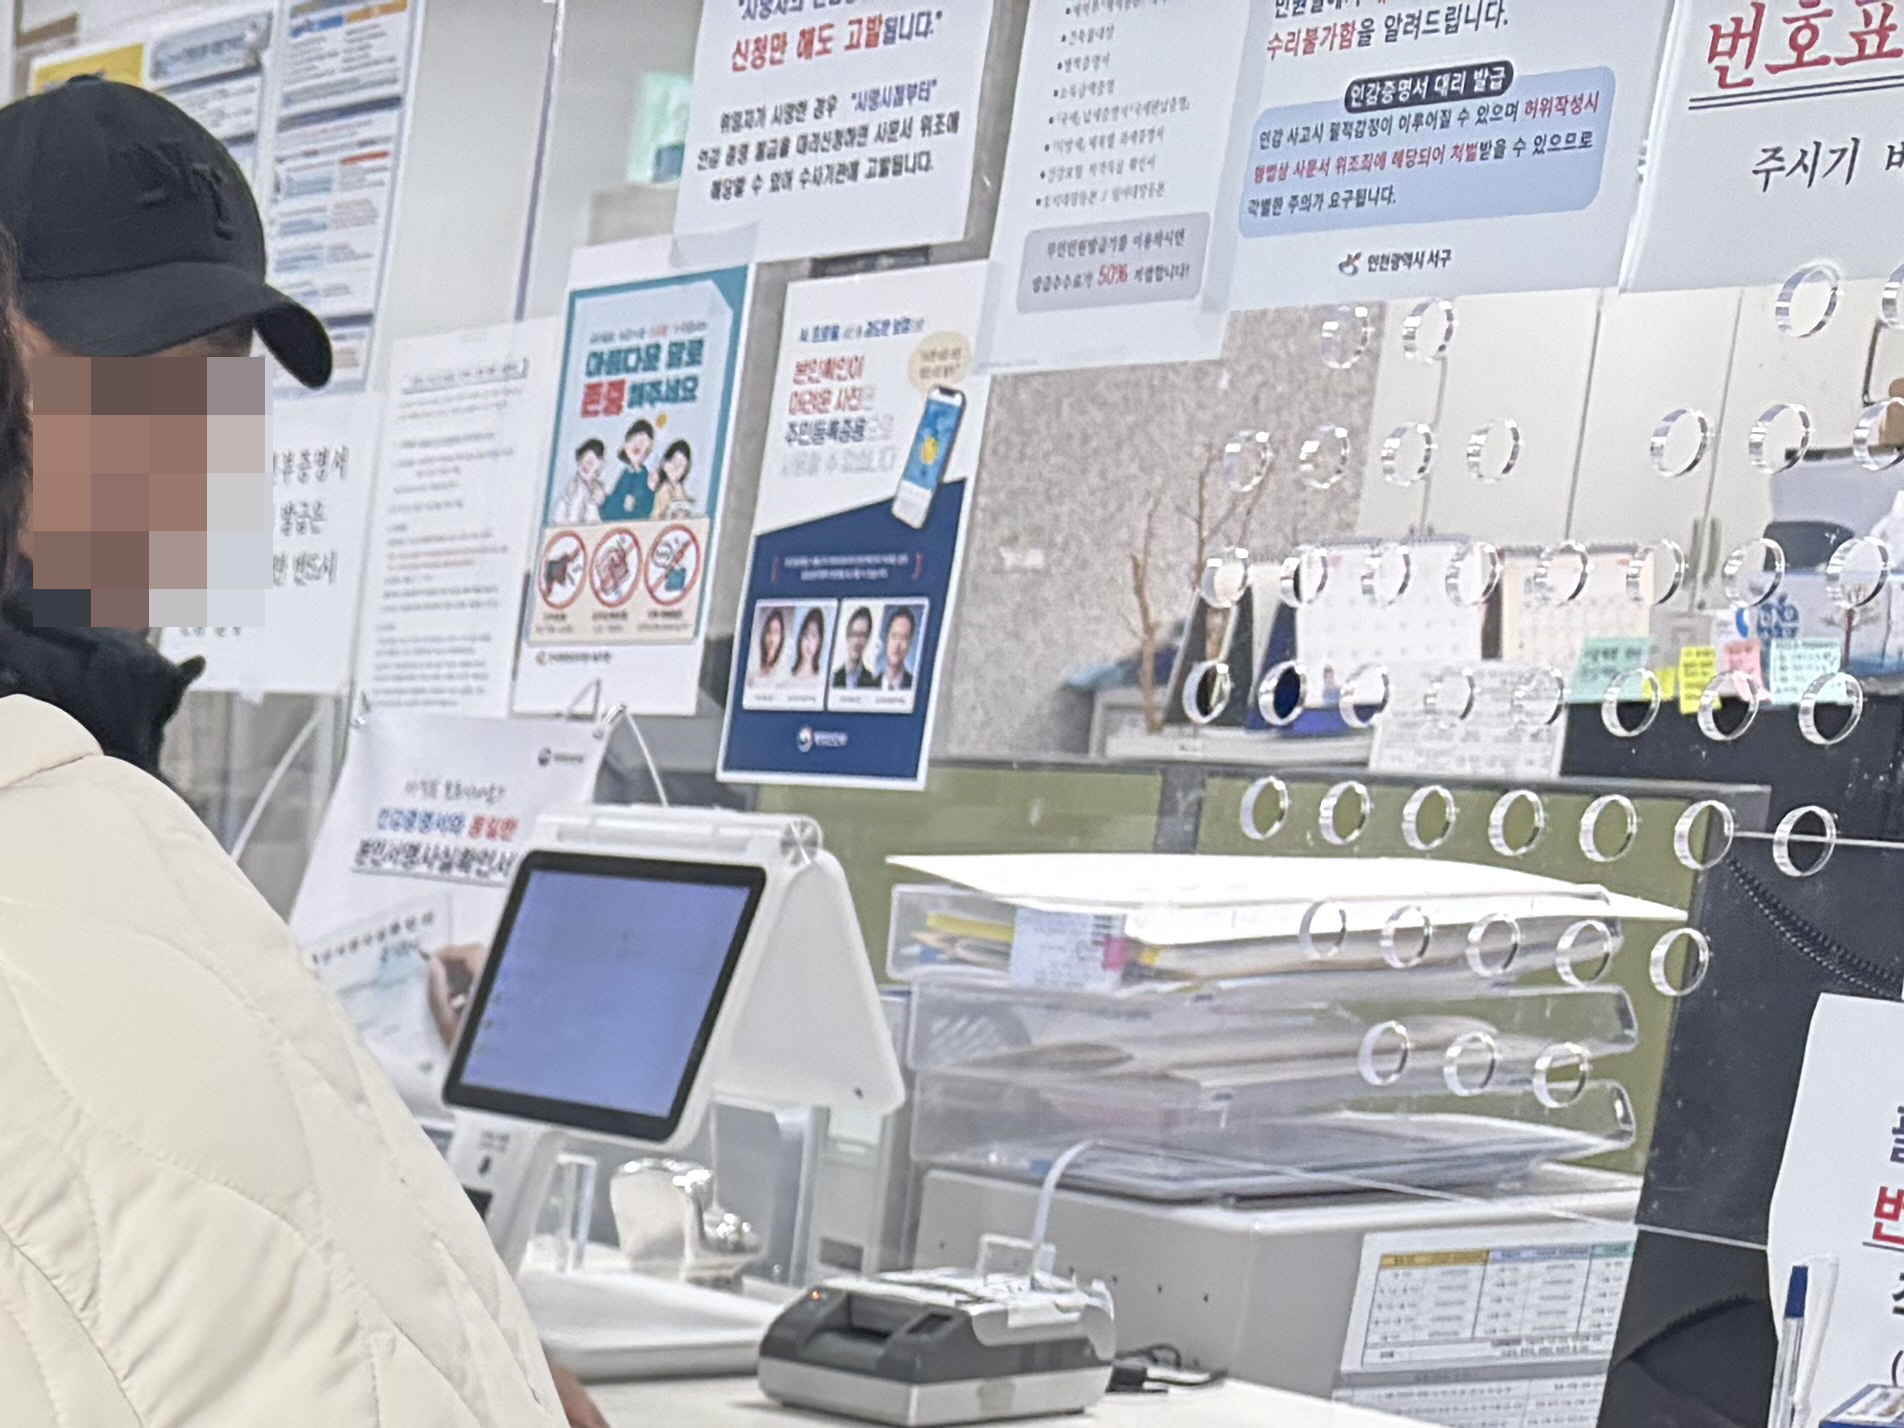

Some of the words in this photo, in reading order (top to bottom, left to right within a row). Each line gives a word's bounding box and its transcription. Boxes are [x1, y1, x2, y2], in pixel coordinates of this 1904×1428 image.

[1267, 17, 1375, 60] 수리불가함을
[1384, 0, 1509, 43] 알려드립니다.
[732, 32, 788, 72] 신청만
[1350, 75, 1428, 107] 인감증명서
[1434, 71, 1467, 97] 대리
[1473, 67, 1506, 92] 발급
[1260, 128, 1283, 150] 인감
[1287, 122, 1324, 146] 사고시
[1399, 109, 1452, 133] 이루어질
[1457, 108, 1470, 127] 수
[1475, 101, 1519, 125] 있으며
[1525, 91, 1600, 119] 허위작성시
[1512, 137, 1526, 157] 수
[1532, 131, 1593, 155] 있으므로
[1752, 137, 1860, 192] 주시기
[751, 174, 763, 195] 수
[1327, 184, 1396, 210] 요구됩니다.
[1097, 263, 1128, 286] 50%
[1367, 250, 1426, 272] 인천광역시
[1427, 249, 1451, 268] 서구
